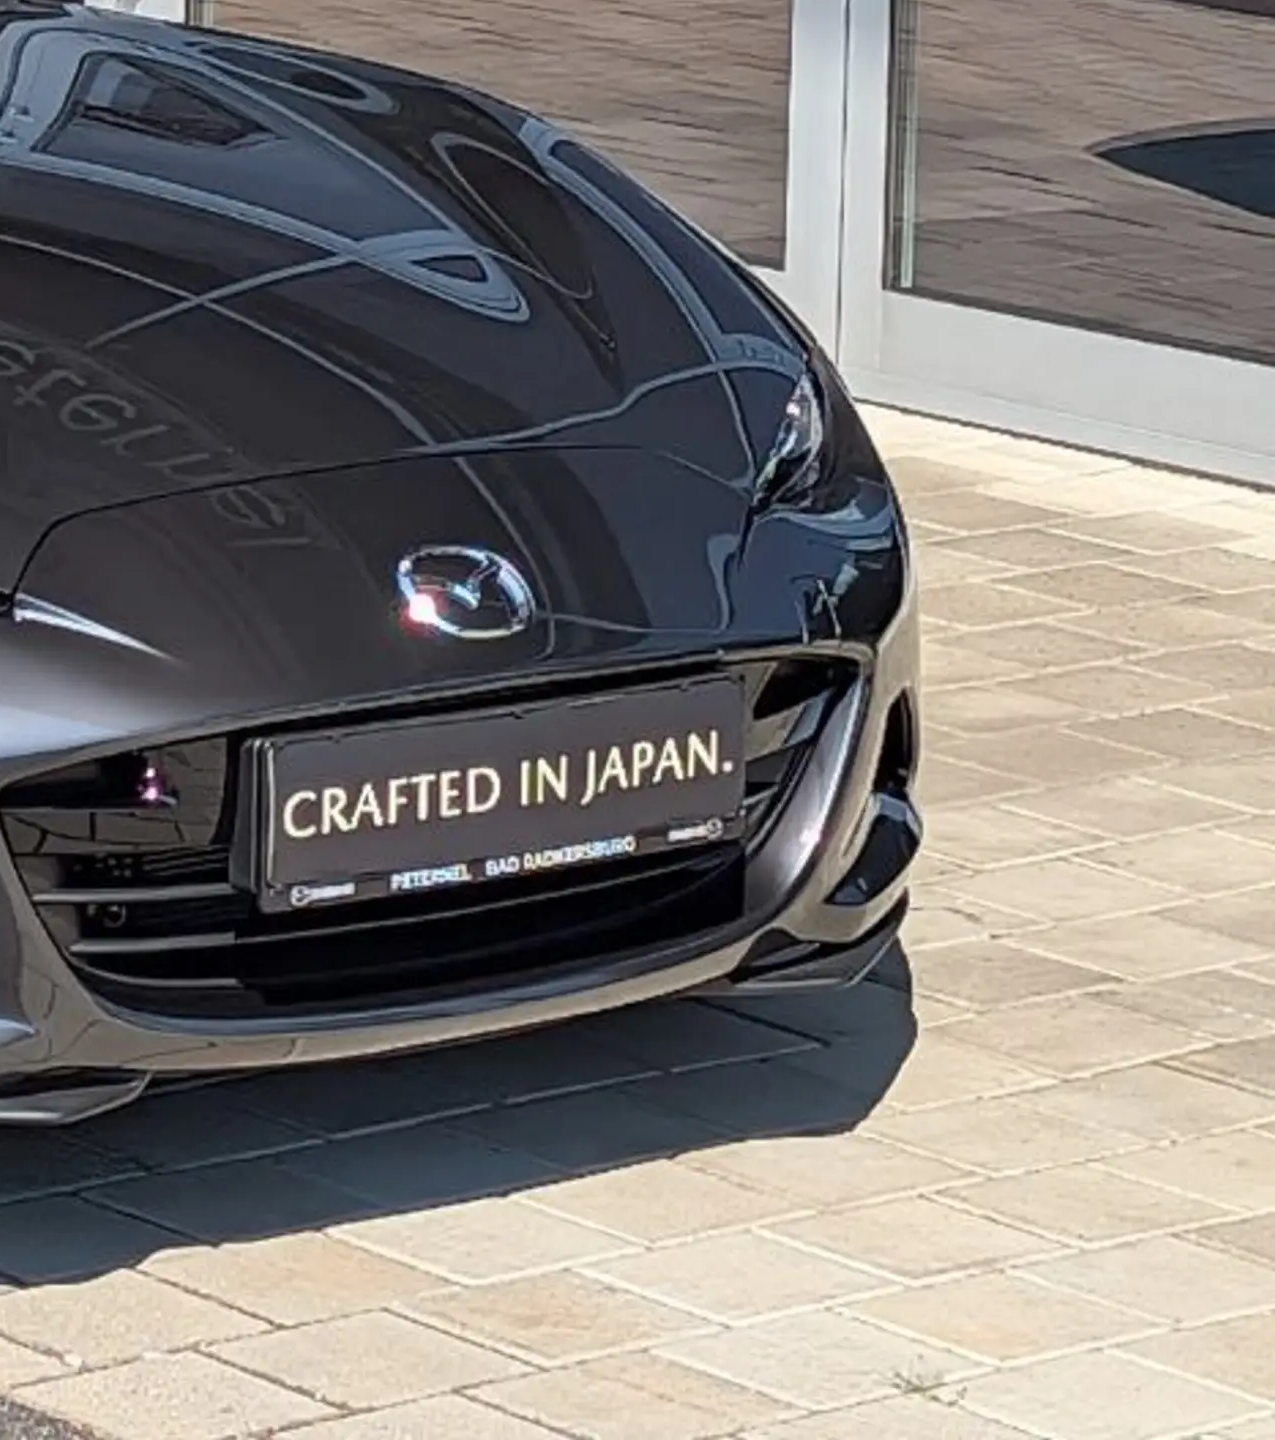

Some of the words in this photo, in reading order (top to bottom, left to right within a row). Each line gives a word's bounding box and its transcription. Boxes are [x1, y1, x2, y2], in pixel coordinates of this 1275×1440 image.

[283, 768, 502, 839] CRAFTED
[520, 755, 569, 806] IN
[581, 729, 734, 806] JAPAN.
